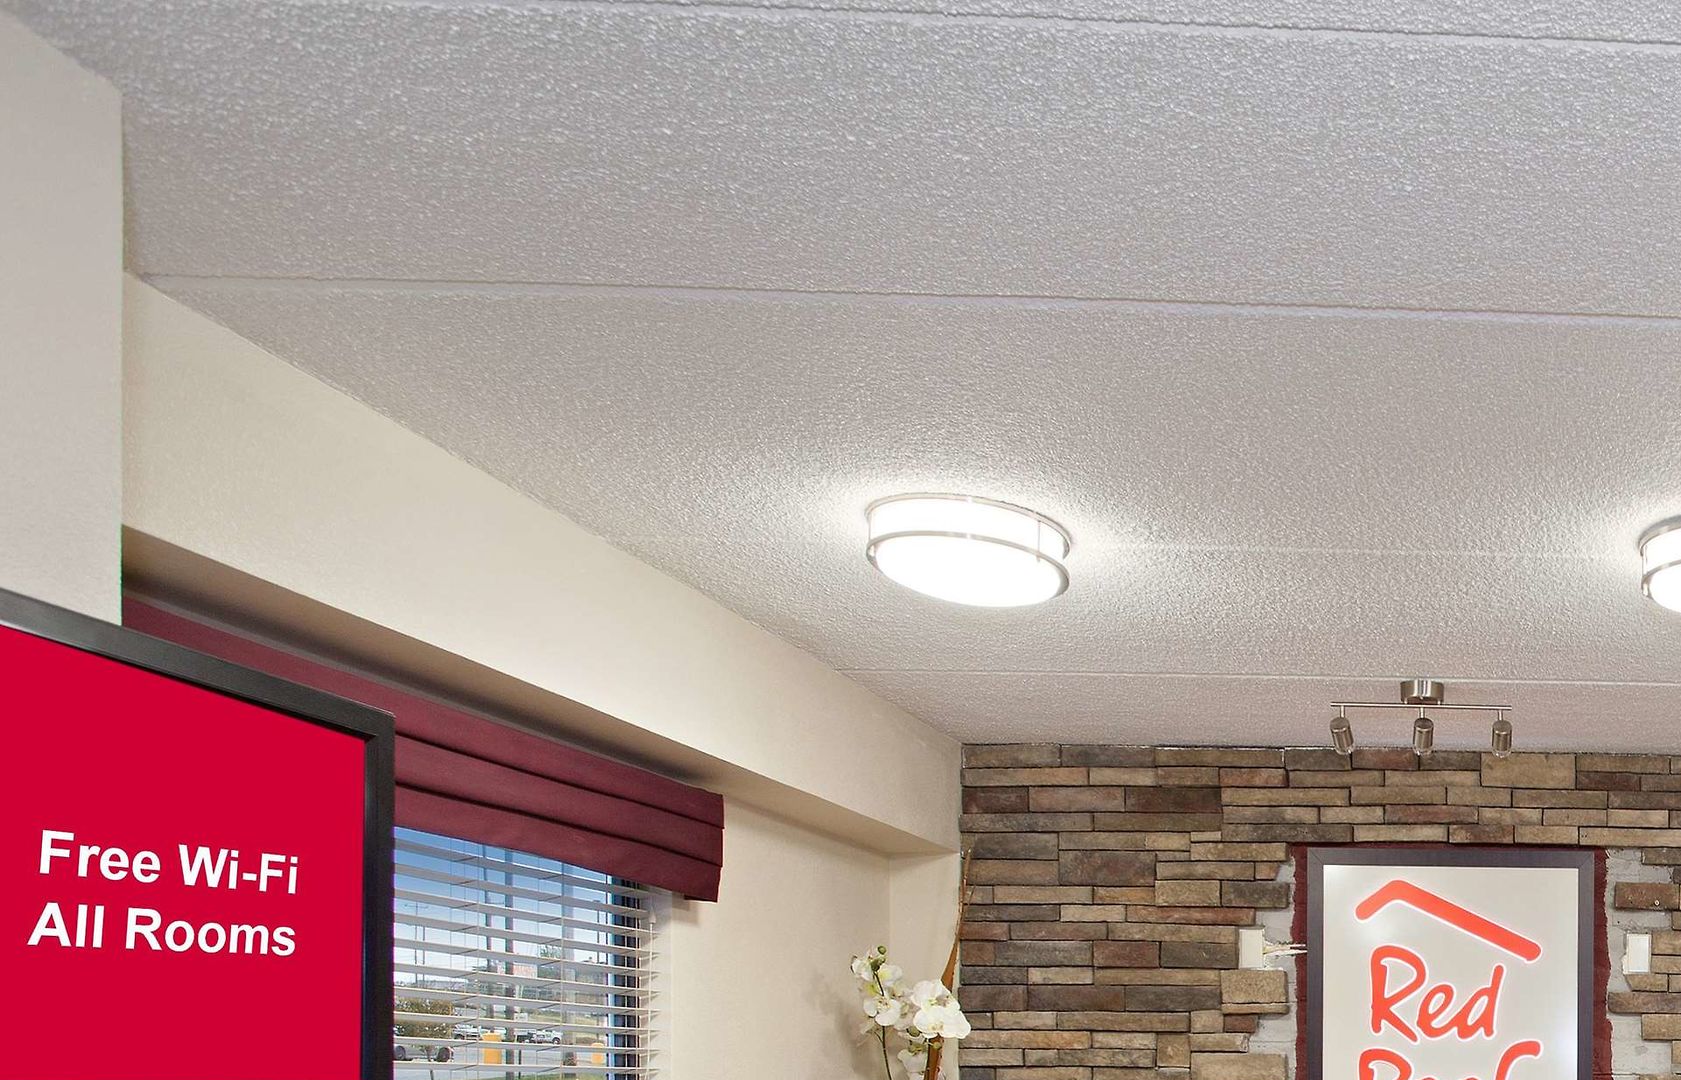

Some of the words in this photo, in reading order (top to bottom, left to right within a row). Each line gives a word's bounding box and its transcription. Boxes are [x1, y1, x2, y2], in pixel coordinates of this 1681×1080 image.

[38, 828, 161, 884] Free
[178, 843, 298, 895] Wi-Fi
[27, 902, 105, 949] All
[125, 906, 297, 957] Rooms
[1371, 945, 1504, 1042] Red
